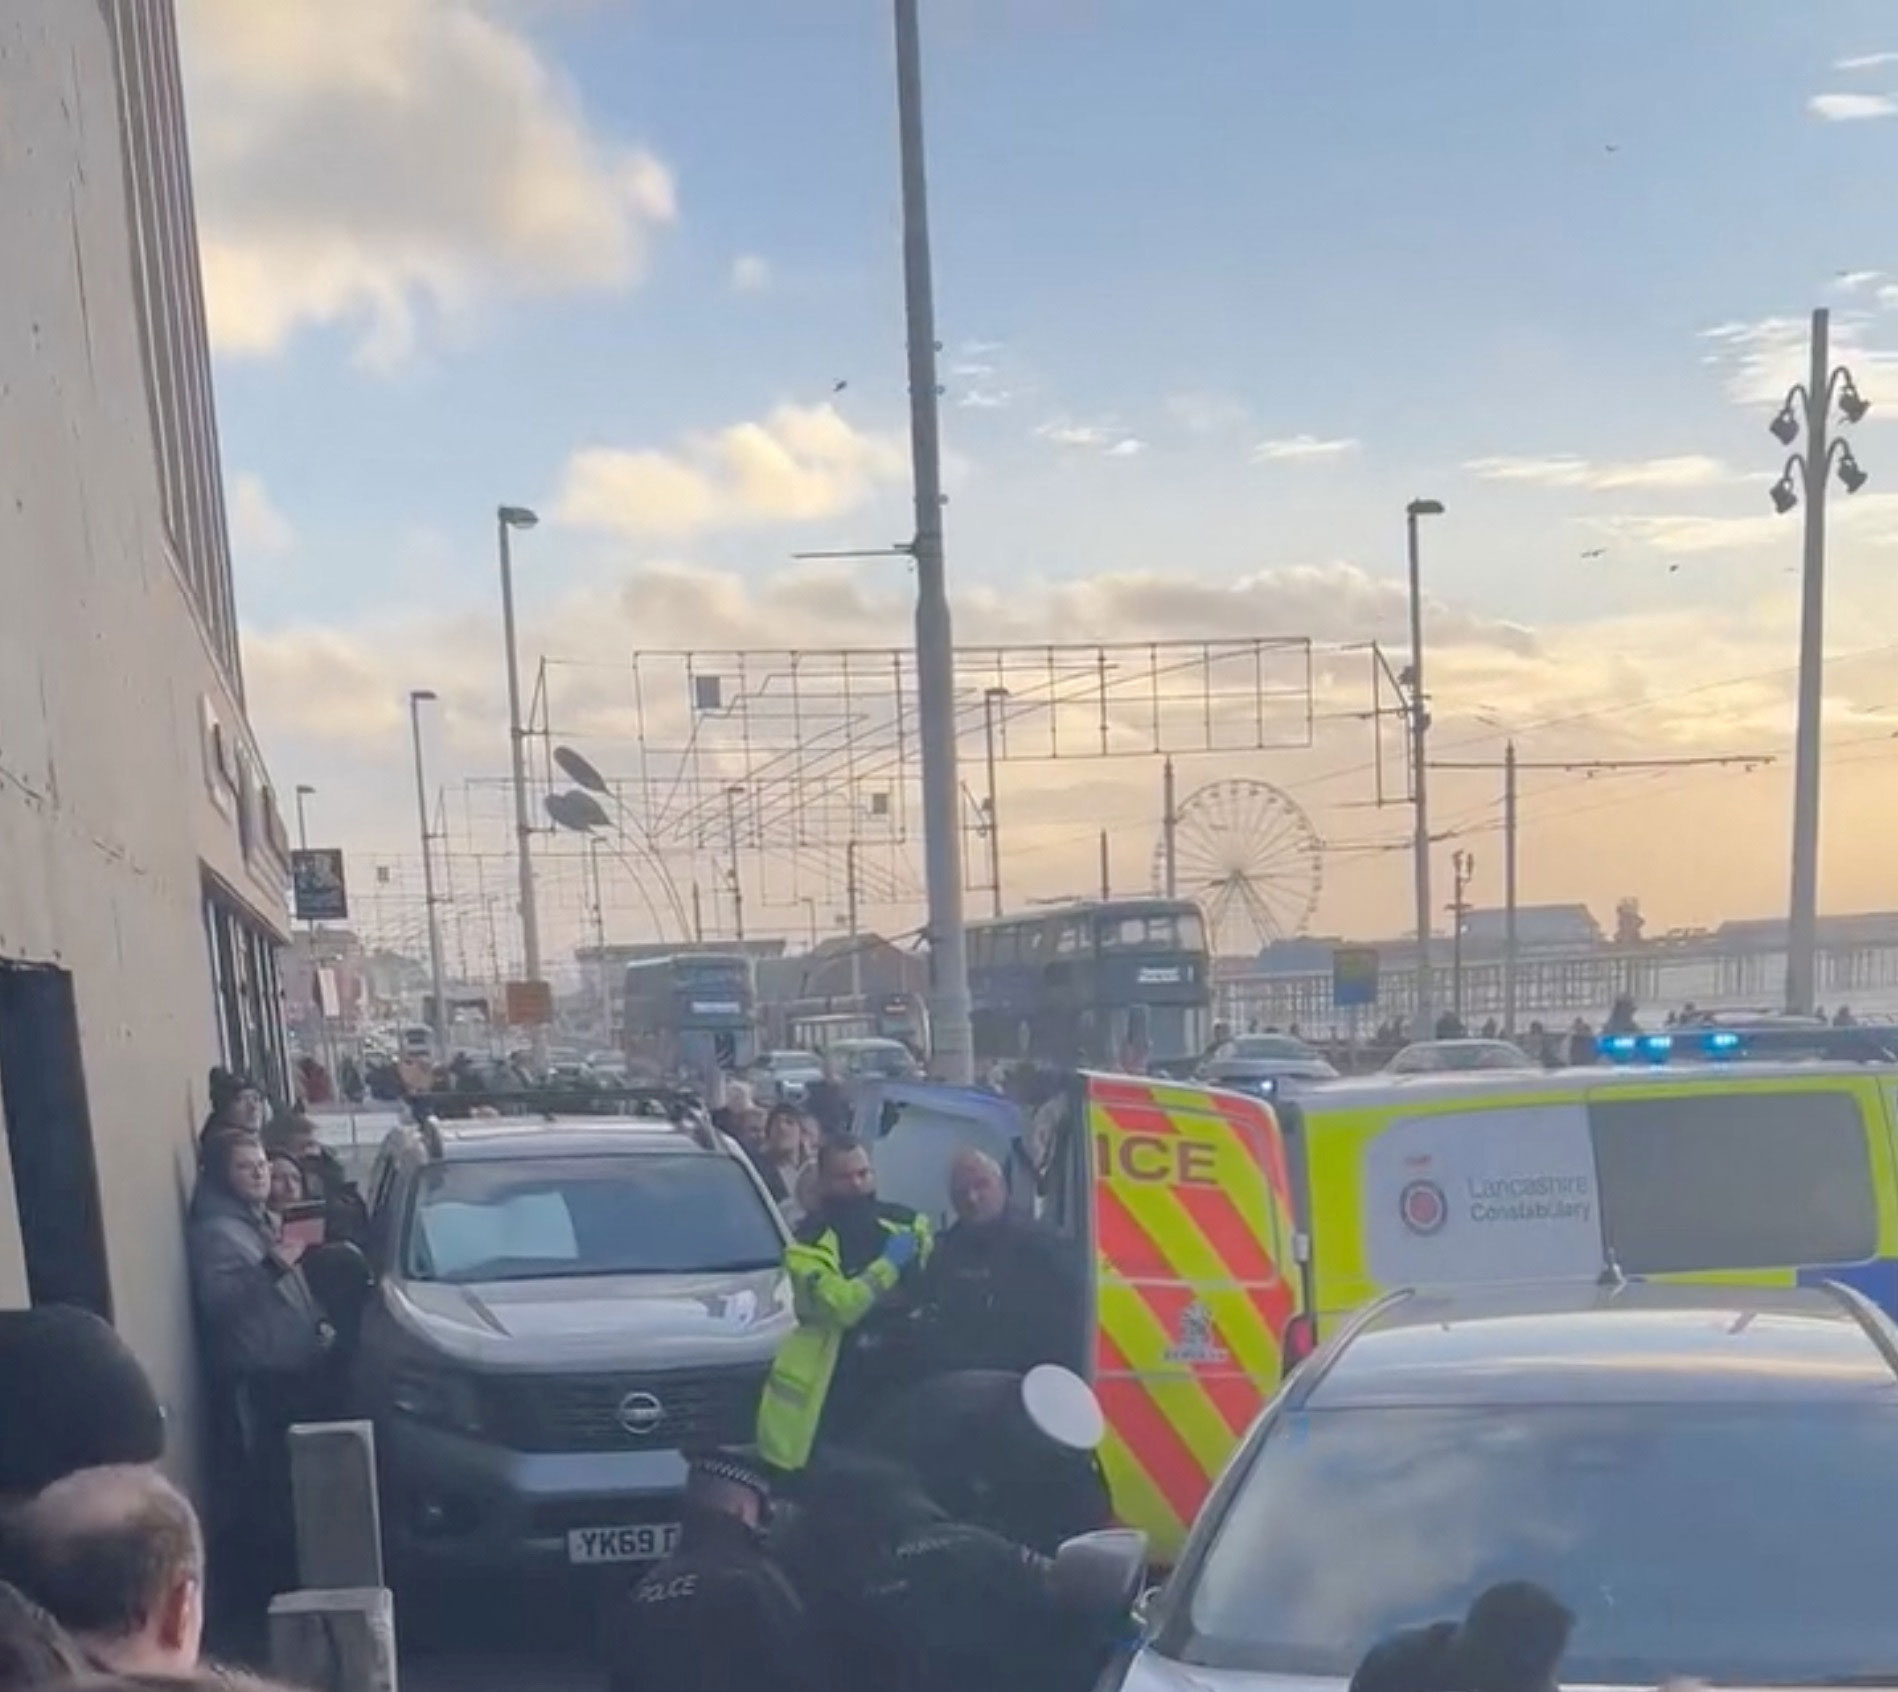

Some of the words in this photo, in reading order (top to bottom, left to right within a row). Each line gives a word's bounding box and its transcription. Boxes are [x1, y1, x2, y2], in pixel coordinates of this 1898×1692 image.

[1097, 1134, 1218, 1184] ICE
[1468, 1174, 1590, 1198] Lancashire
[1470, 1200, 1591, 1222] Constabulary
[581, 1530, 655, 1556] YK69
